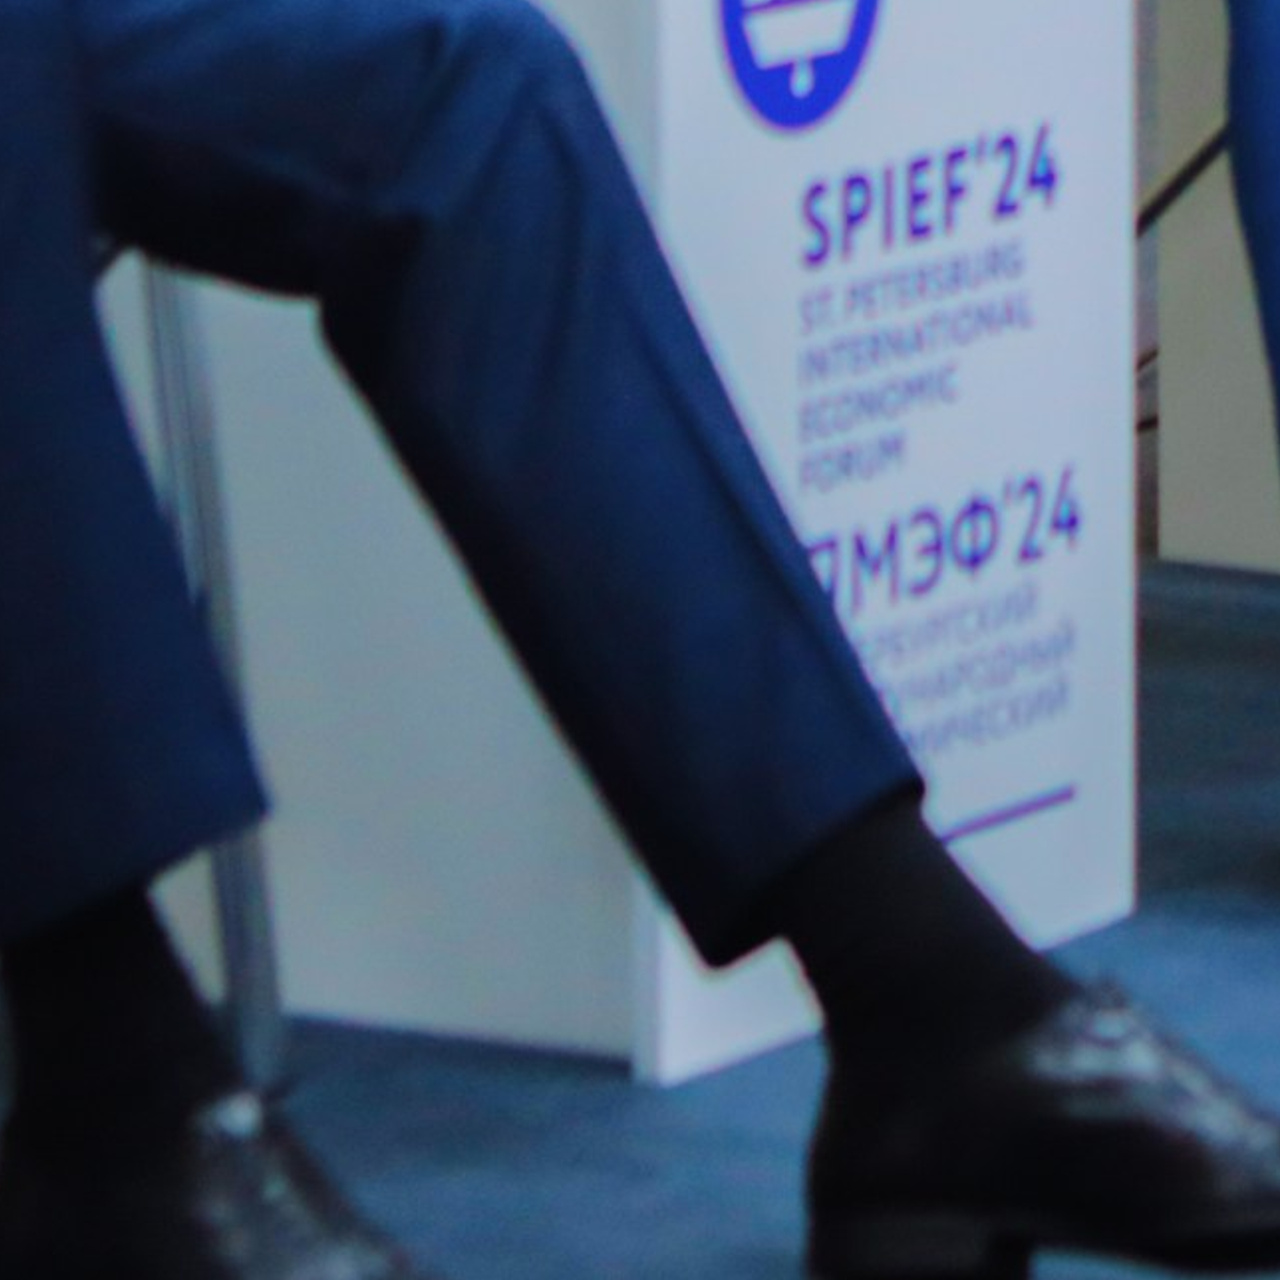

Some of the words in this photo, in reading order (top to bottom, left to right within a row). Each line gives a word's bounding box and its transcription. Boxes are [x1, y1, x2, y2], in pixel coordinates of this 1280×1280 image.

[801, 120, 1057, 268] SPIEF'24
[844, 237, 1025, 319] PETERSBURG
[799, 290, 1037, 385] INTERNATIONAL
[799, 359, 960, 445] ECONOMIC
[799, 426, 907, 495] FORUM
